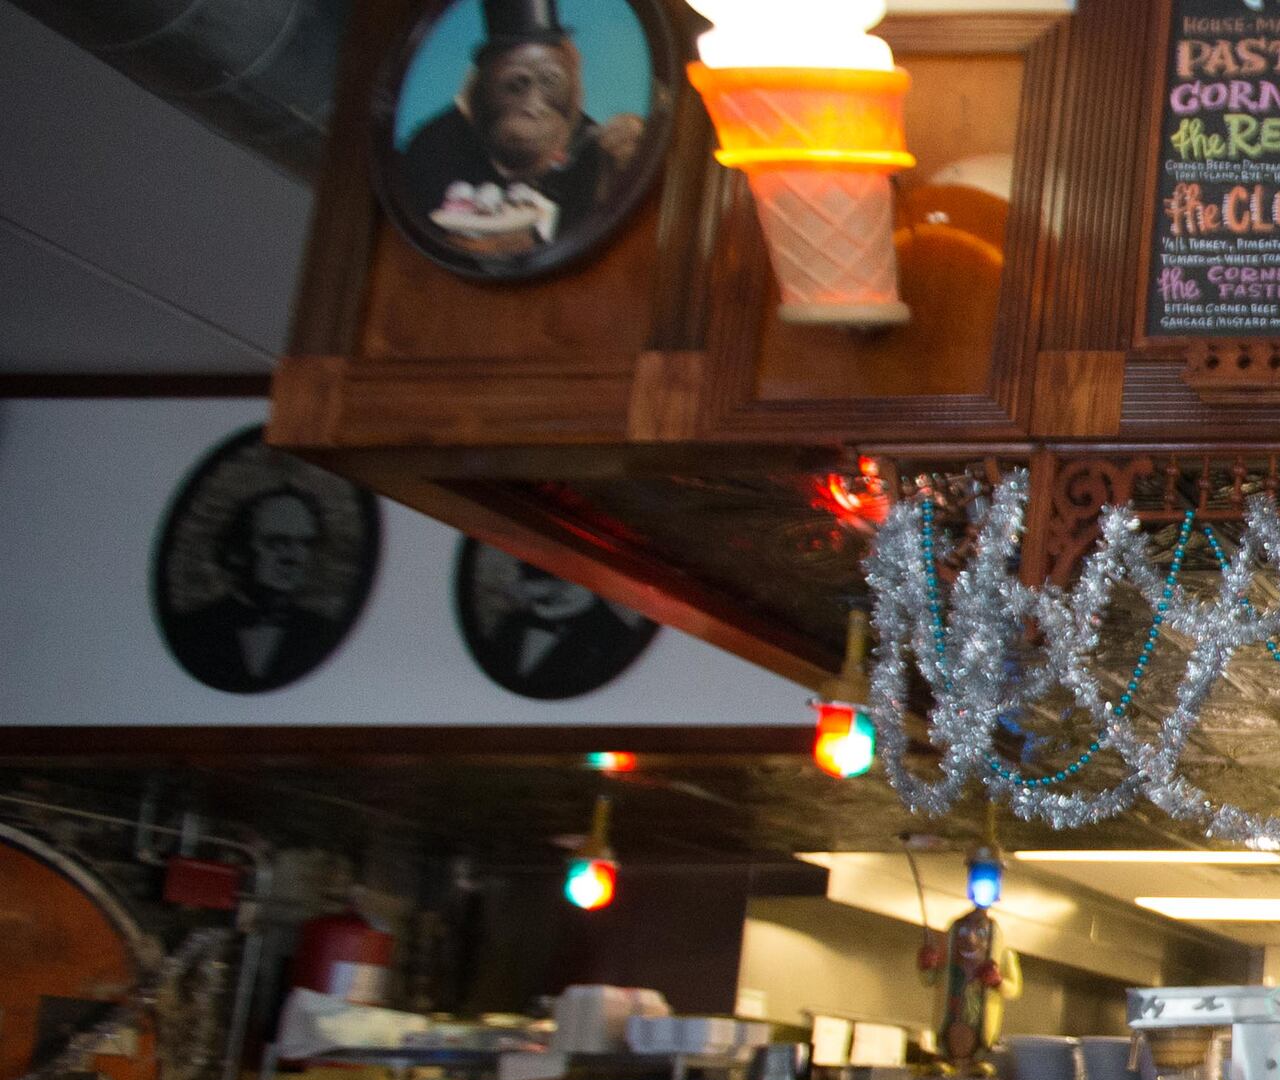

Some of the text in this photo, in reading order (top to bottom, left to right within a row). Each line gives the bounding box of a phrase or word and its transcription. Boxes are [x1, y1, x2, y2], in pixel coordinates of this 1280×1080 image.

[1171, 117, 1225, 160] the
[1163, 183, 1220, 236] the
[1157, 266, 1199, 302] the
[1160, 316, 1213, 328] SAUSAGE
[1215, 317, 1268, 329] MUSTARD
[1164, 302, 1206, 314] EITHER
[1206, 303, 1247, 314] CORNED
[1251, 303, 1278, 313] BEEF
